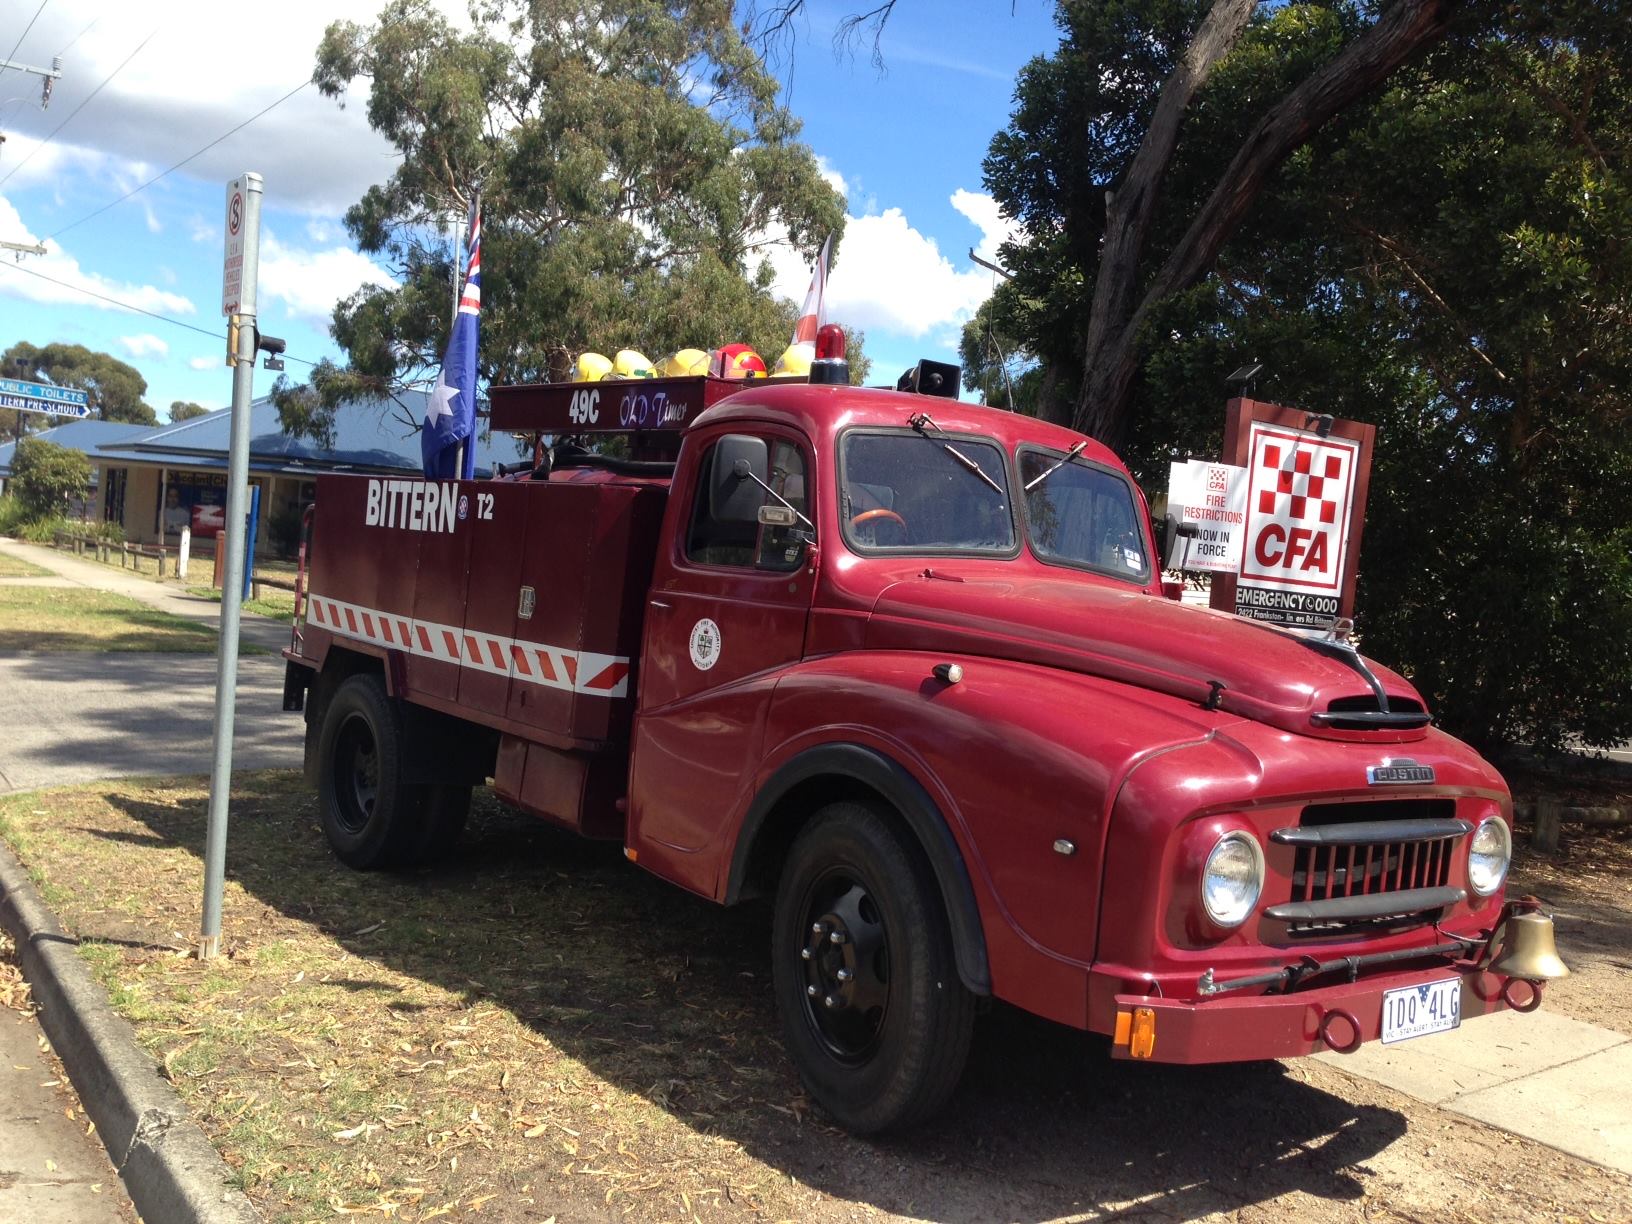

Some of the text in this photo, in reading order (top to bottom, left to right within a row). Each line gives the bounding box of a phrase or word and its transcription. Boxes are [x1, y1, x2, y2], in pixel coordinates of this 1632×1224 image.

[40, 387, 84, 402] TOILETS
[27, 399, 81, 416] PRE-SCHOOL
[569, 388, 687, 427] 49C OLD Timer
[1209, 481, 1225, 490] CFA
[365, 479, 494, 534] BITTERN T2
[1206, 494, 1226, 507] FIRE
[1184, 506, 1243, 524] RESTRICTIONS
[1196, 528, 1230, 543] NOW IN
[1197, 543, 1227, 557] FORCE
[1255, 523, 1329, 574] CFA
[1235, 587, 1338, 614] EMERGENCY 000
[1376, 767, 1432, 781] AUSTIN
[1389, 986, 1458, 1031] 1DQ 4LG
